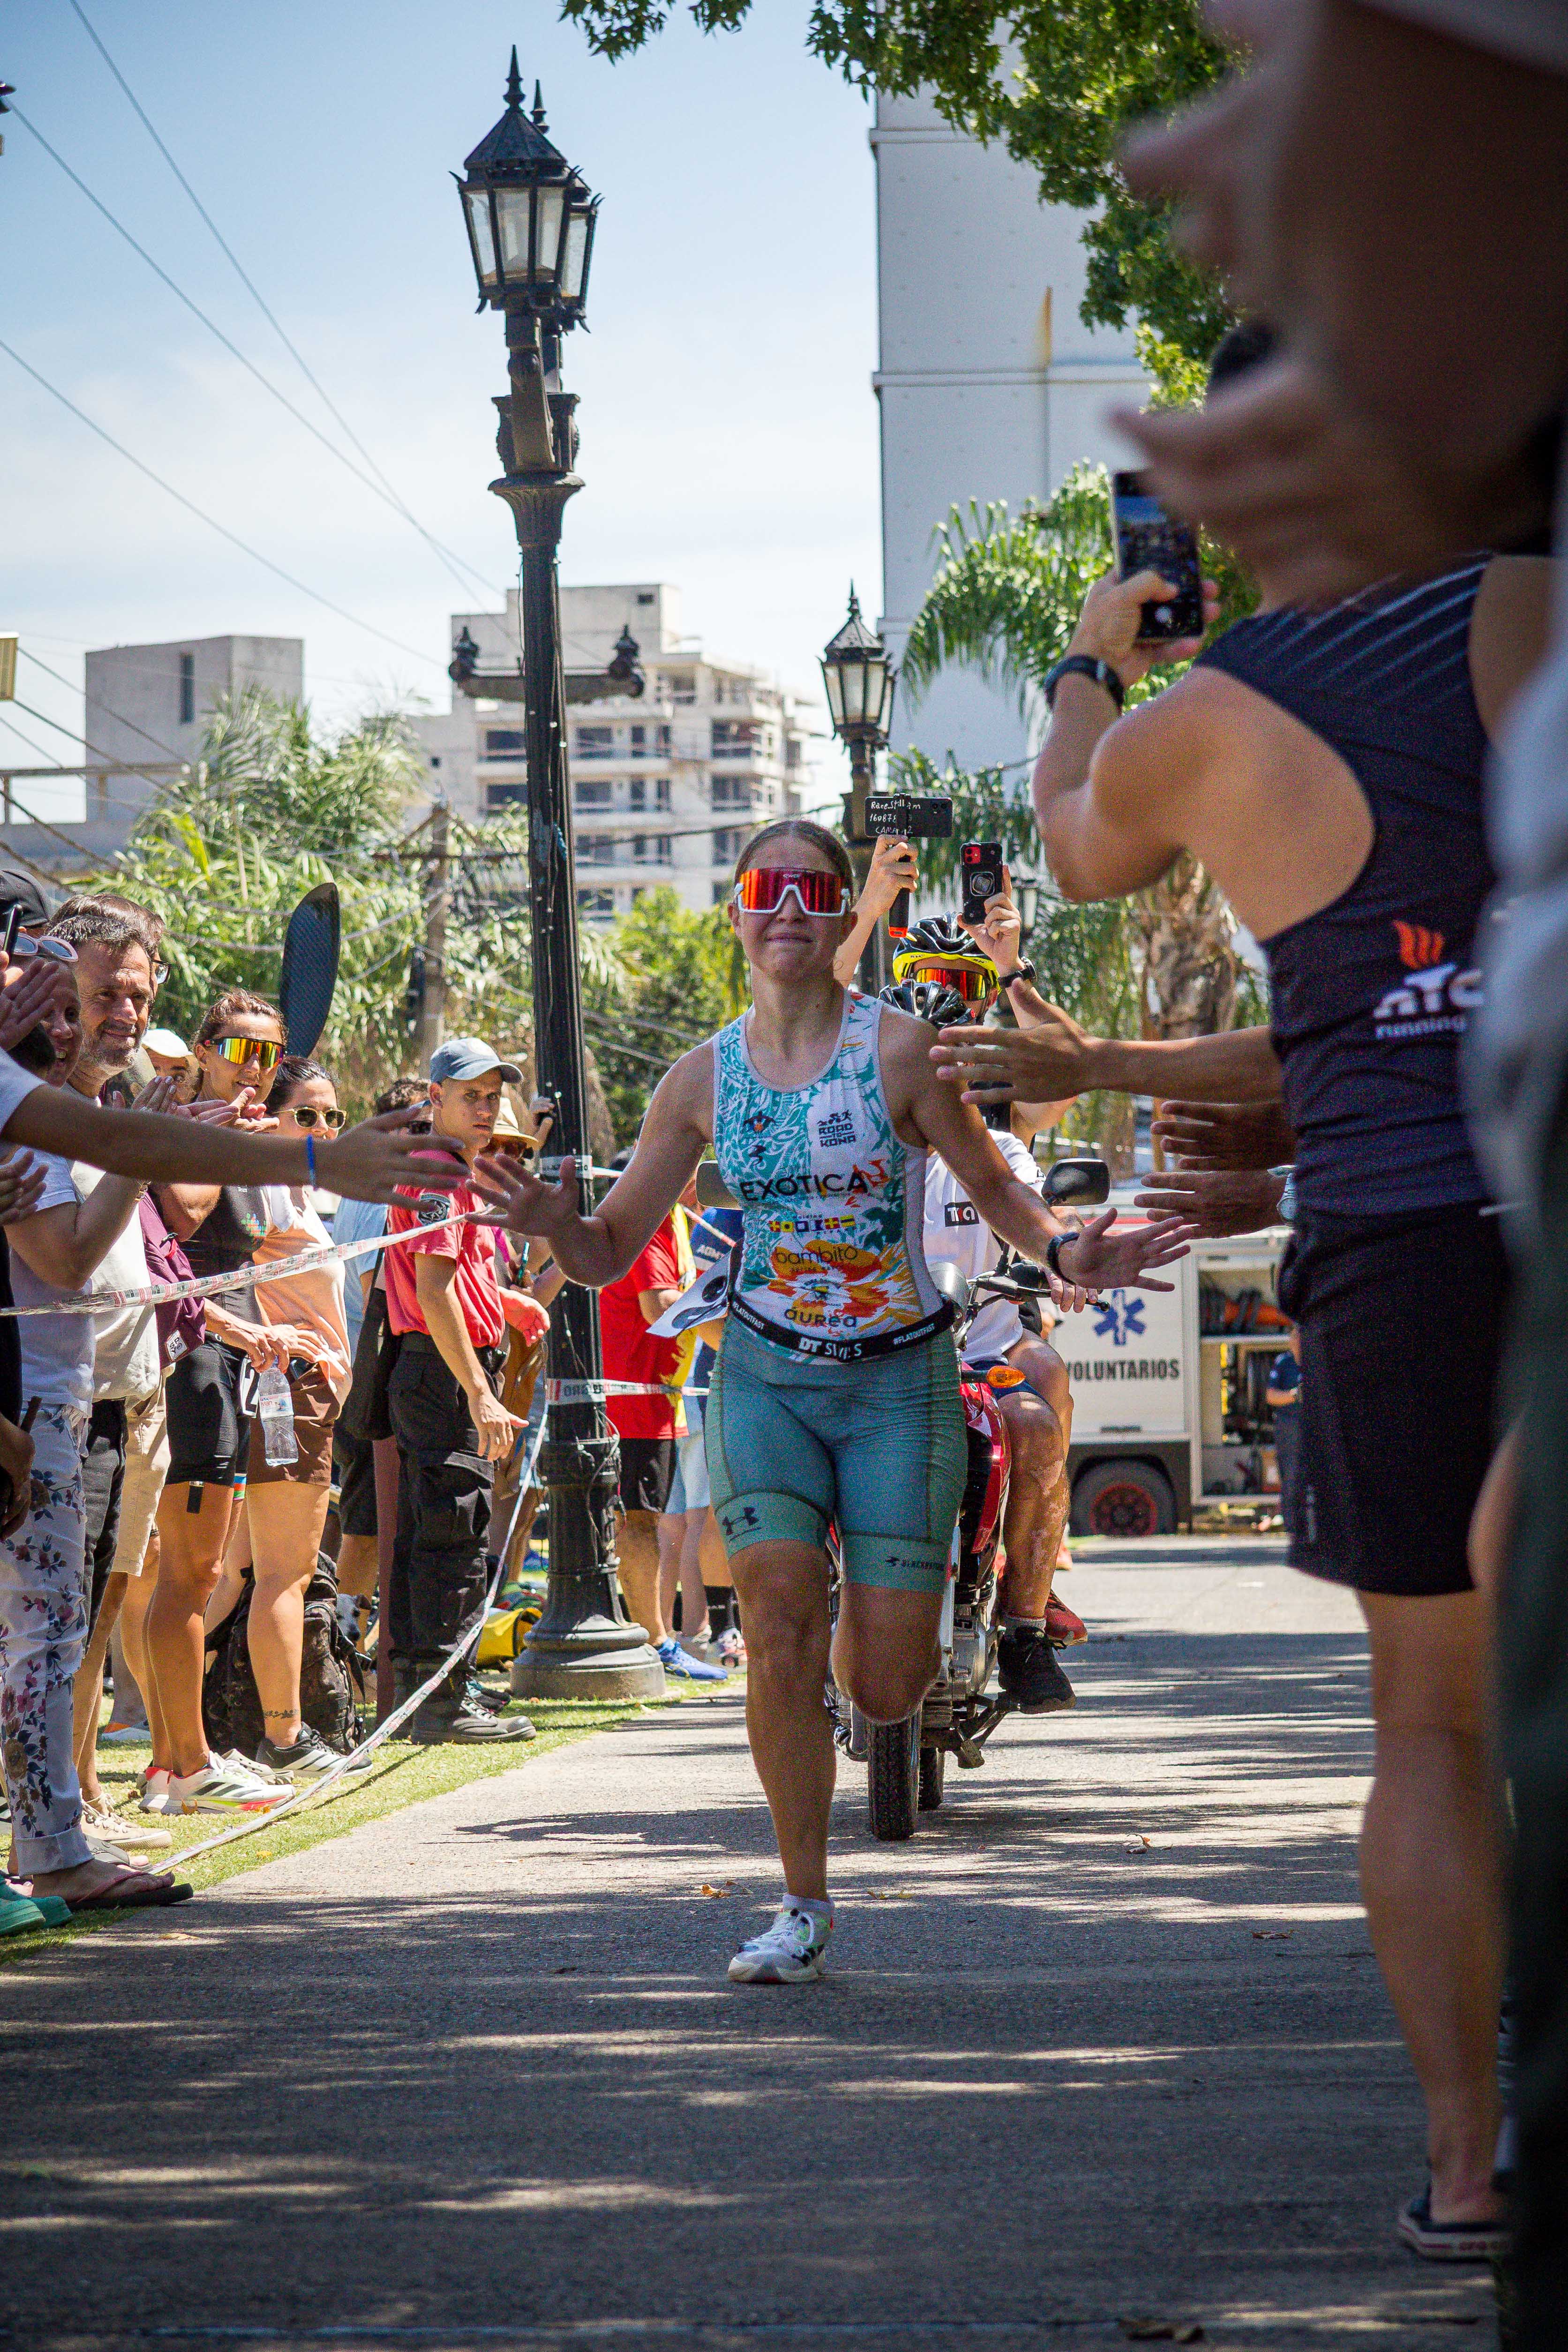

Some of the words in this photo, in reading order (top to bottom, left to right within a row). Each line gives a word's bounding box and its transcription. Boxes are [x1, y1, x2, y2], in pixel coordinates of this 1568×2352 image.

[818, 1123, 853, 1134] ROAD
[819, 1135, 856, 1147] KONA
[798, 1337, 822, 1353] DT
